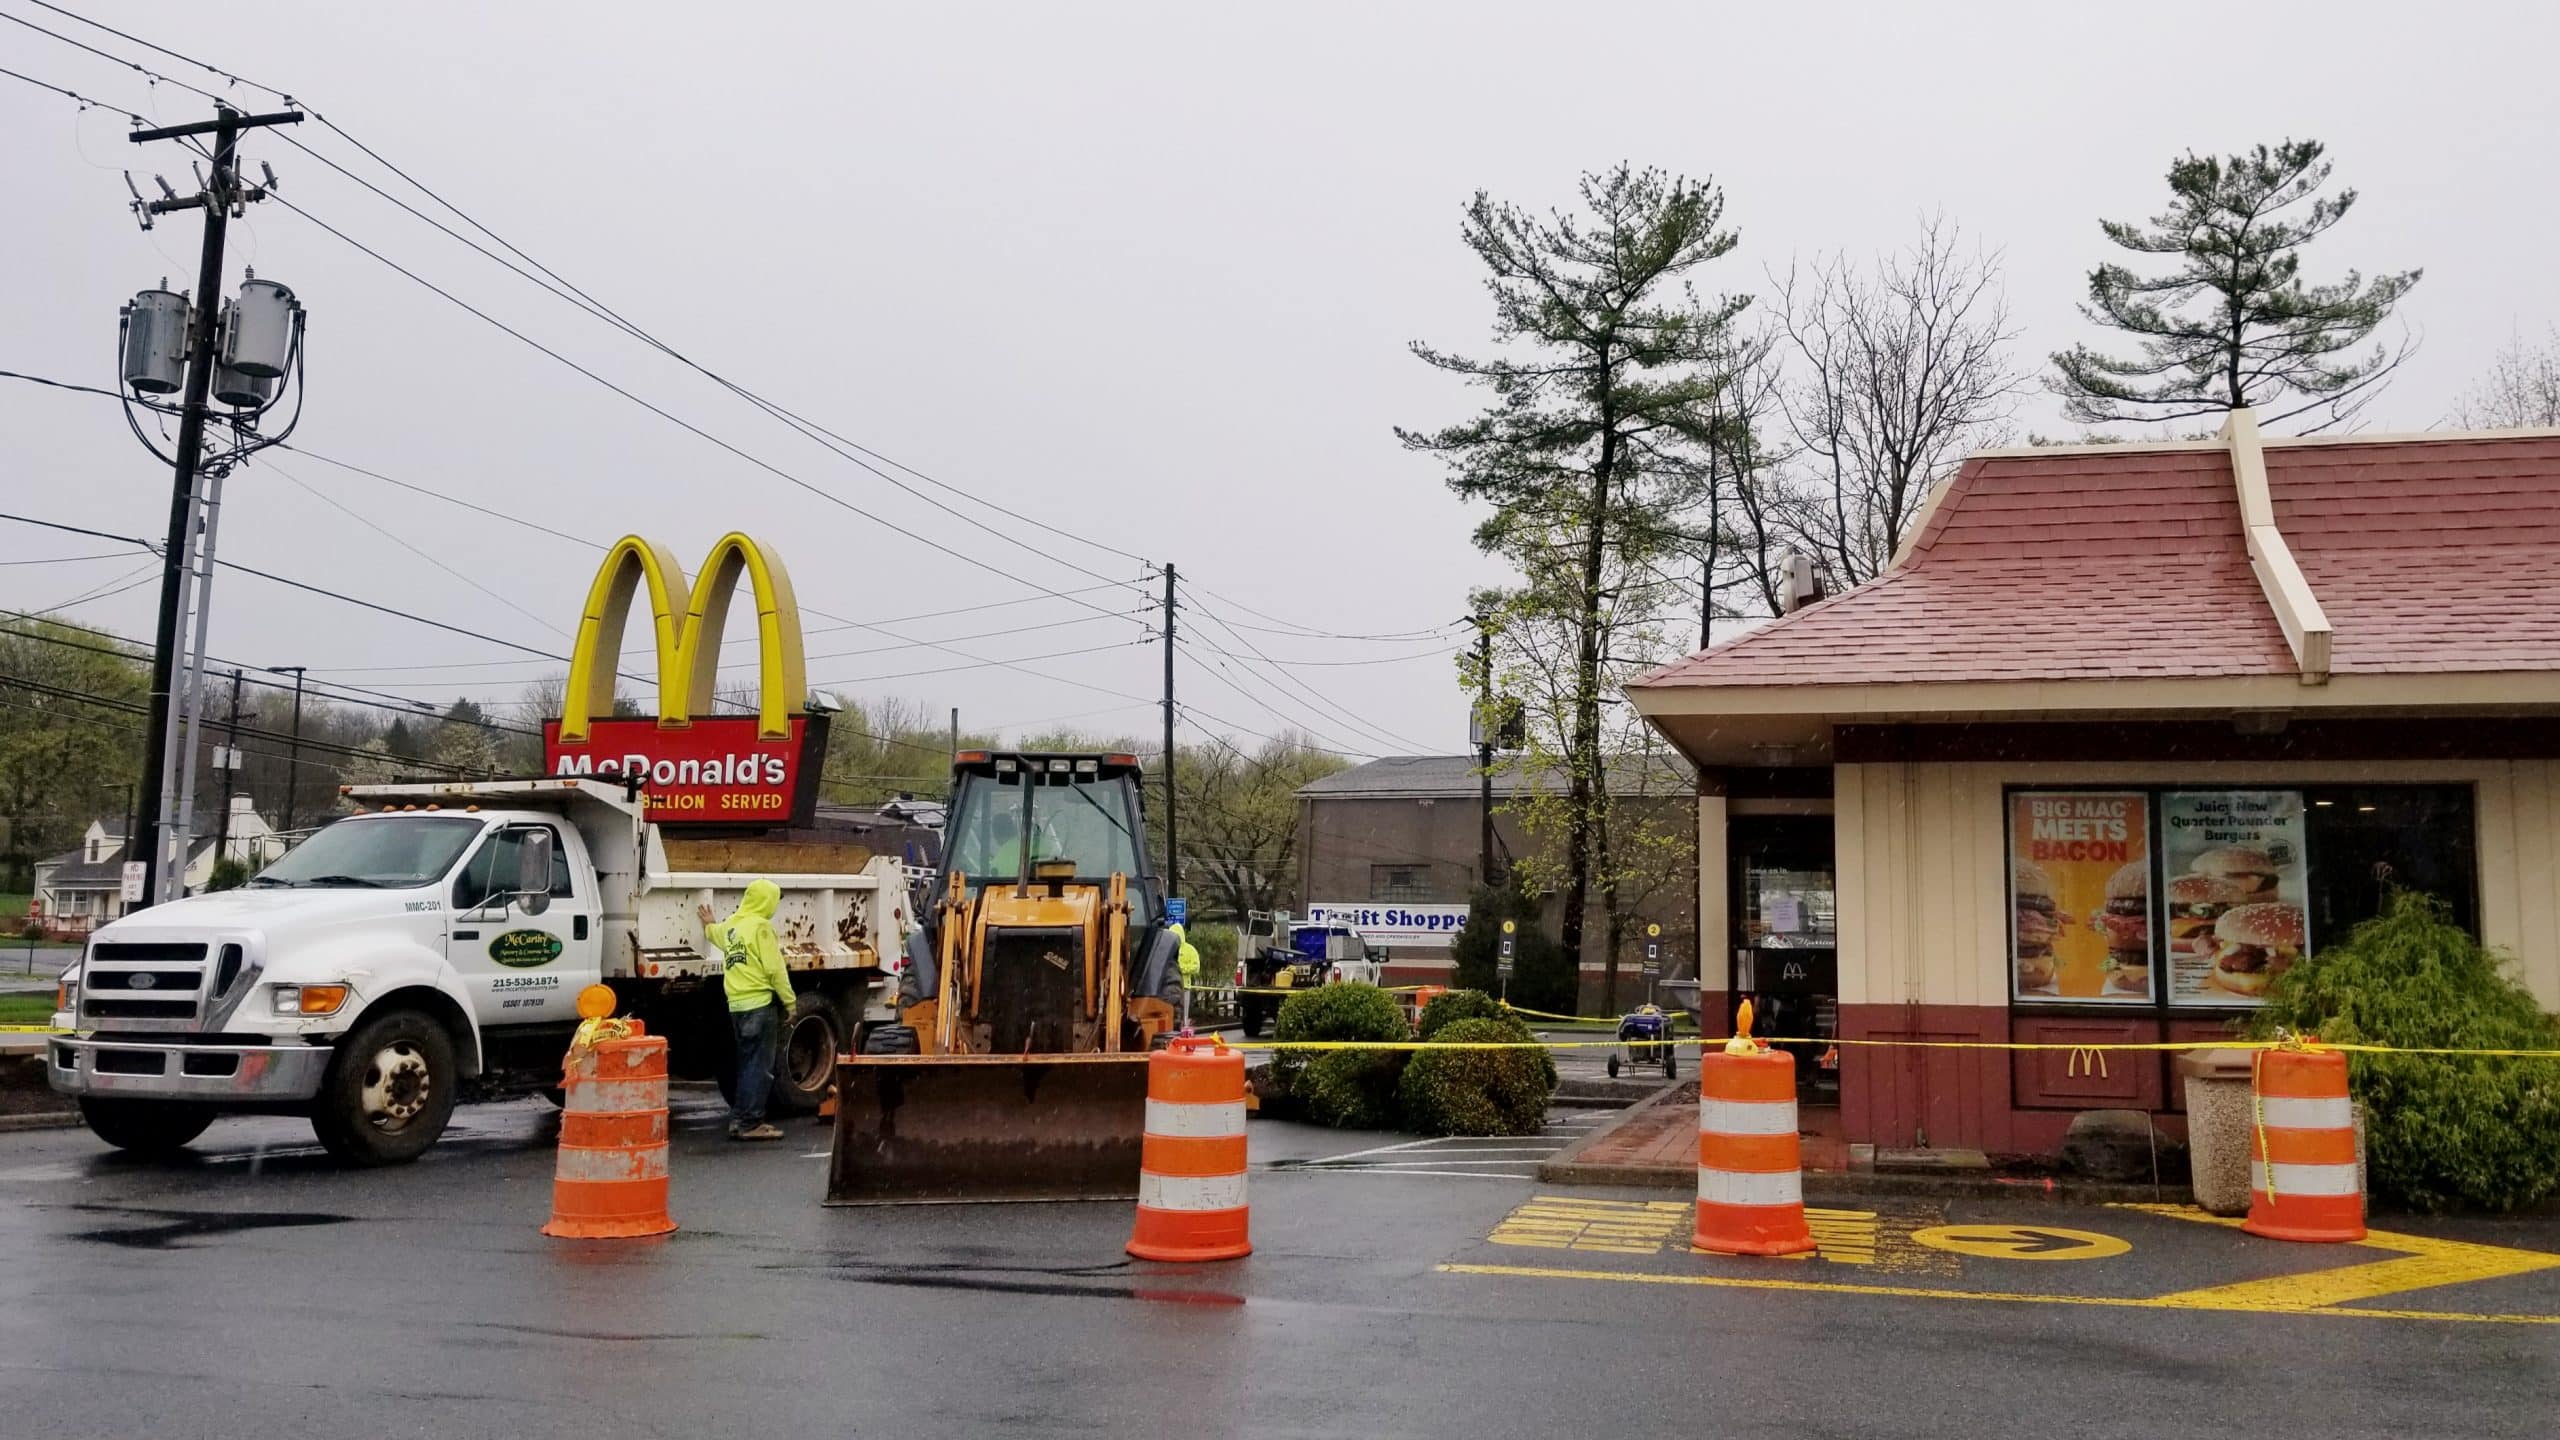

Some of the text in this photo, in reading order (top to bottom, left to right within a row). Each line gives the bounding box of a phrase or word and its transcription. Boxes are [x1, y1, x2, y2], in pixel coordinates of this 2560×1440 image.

[557, 753, 786, 786] McDonald's
[721, 793, 783, 810] SERVED
[2031, 801, 2127, 818] BIG MAC
[2195, 800, 2268, 815] Juicy New
[2031, 818, 2127, 840] MEETS
[2170, 815, 2288, 829] Quarter Pounder
[2205, 830, 2261, 843] Burgers
[2032, 841, 2128, 862] BACON
[405, 900, 442, 912] MMC-201
[1385, 910, 1468, 930] Shoppe
[492, 976, 559, 987] 215-538-1874
